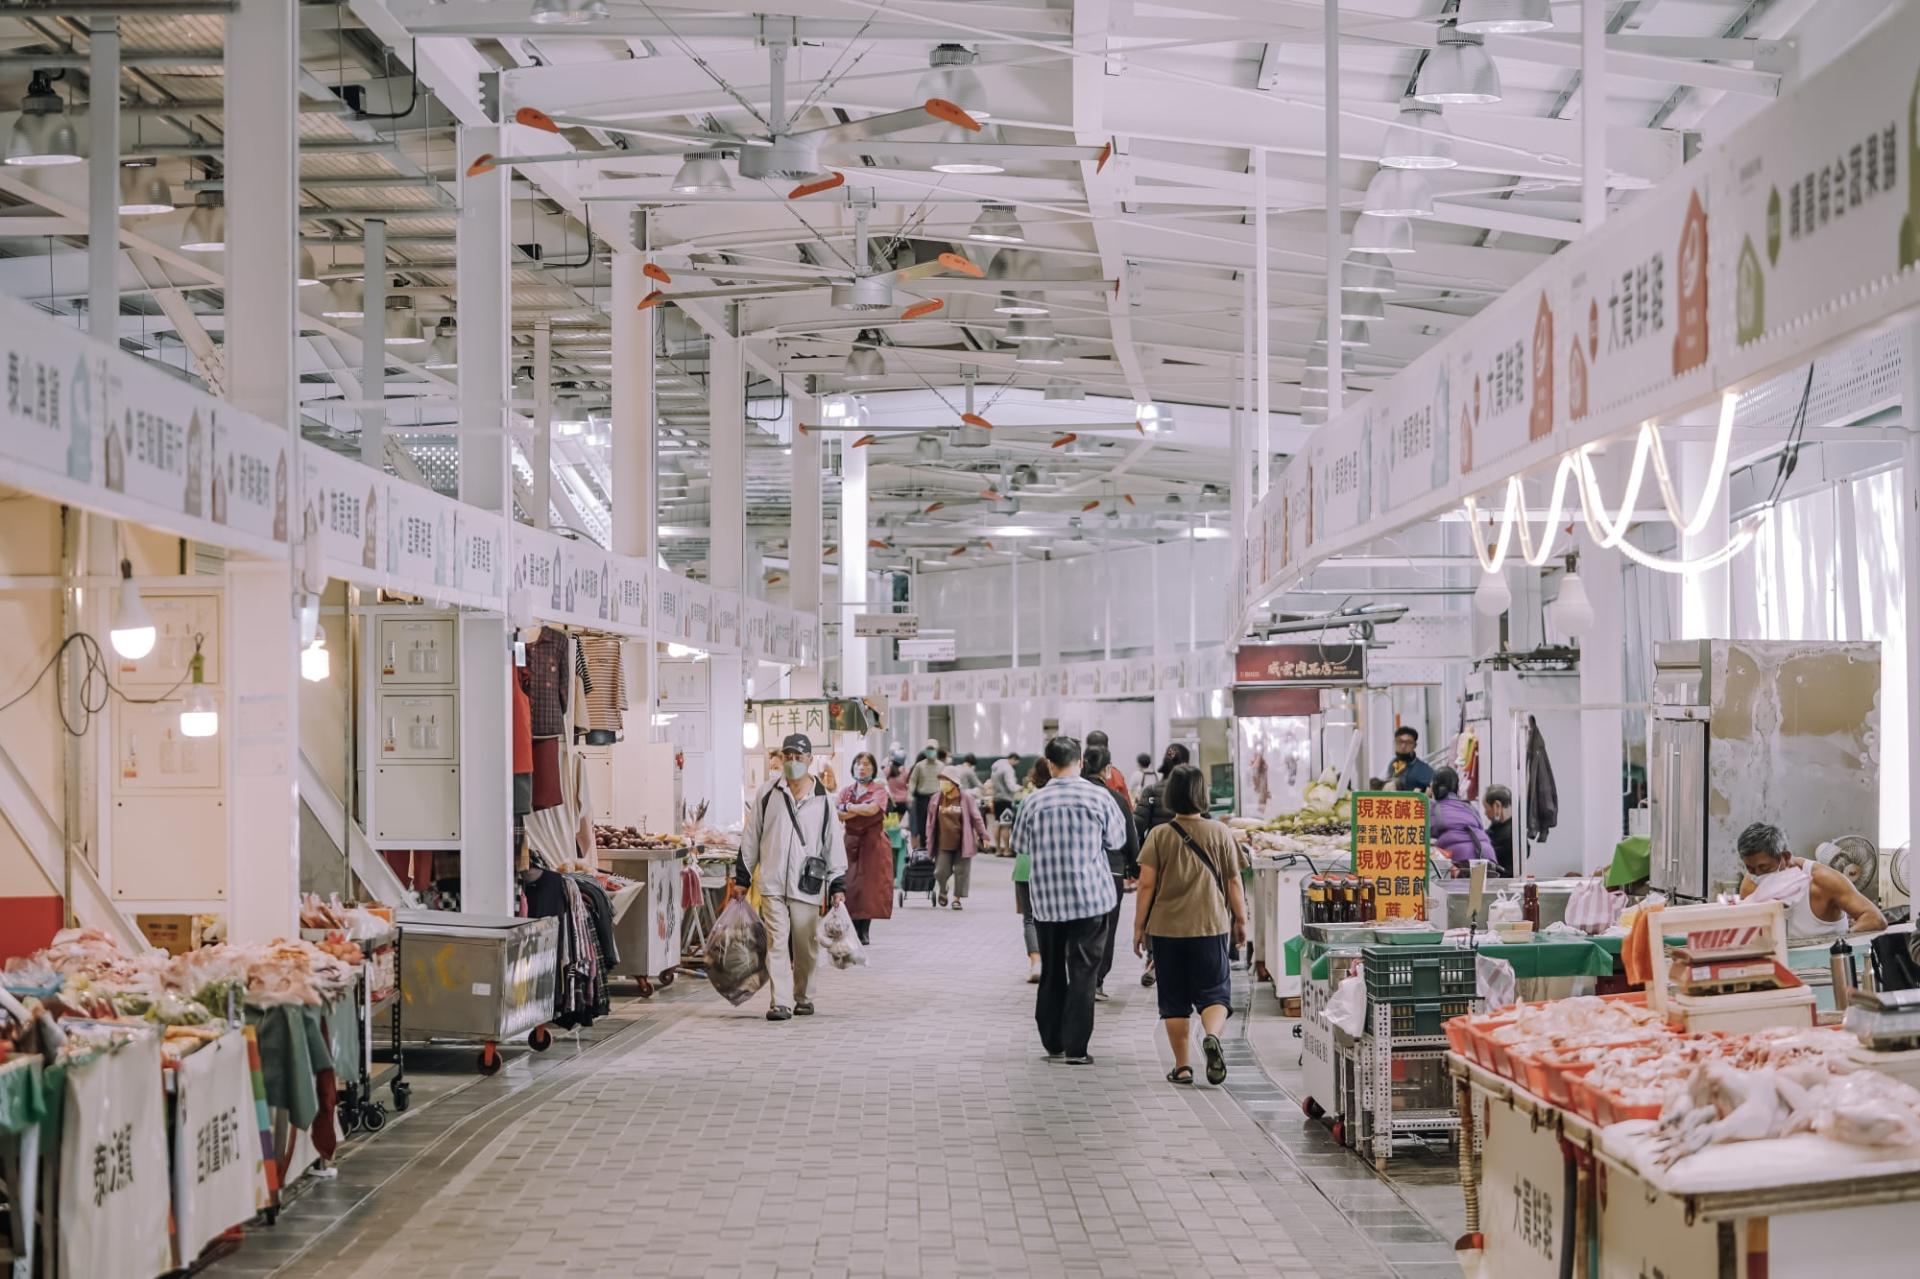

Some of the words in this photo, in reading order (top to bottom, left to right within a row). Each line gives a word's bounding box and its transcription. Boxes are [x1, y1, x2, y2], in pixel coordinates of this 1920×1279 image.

[768, 706, 823, 737] 牛羊肉
[1357, 799, 1425, 819] 現蒸鹹蛋
[1357, 849, 1426, 870] 現炒花生
